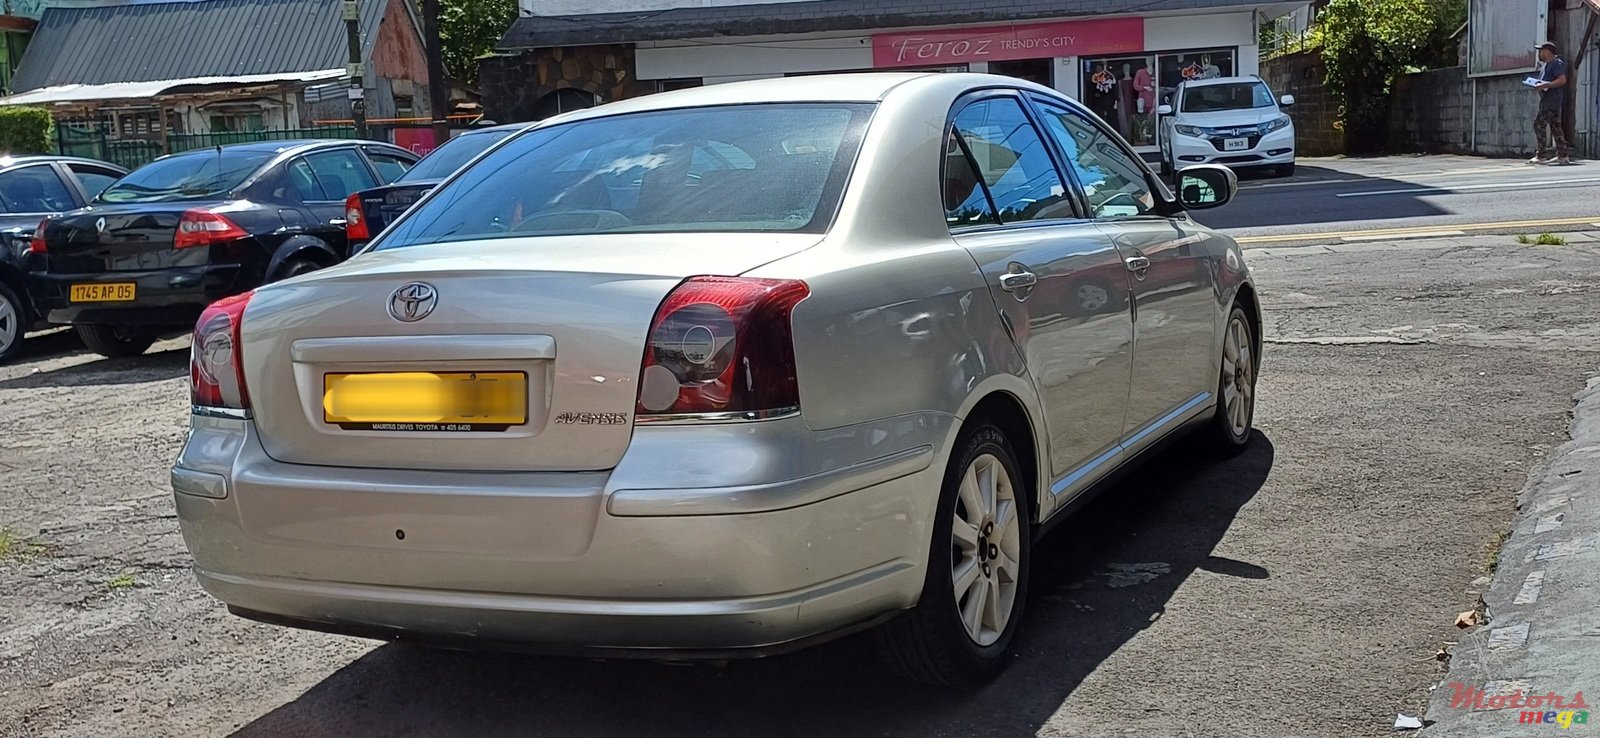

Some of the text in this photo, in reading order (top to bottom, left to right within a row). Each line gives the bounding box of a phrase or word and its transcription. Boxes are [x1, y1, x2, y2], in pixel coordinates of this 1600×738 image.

[891, 37, 993, 62] Feroz
[1000, 37, 1050, 50] TRENDY'S
[1052, 35, 1076, 47] CITY
[75, 285, 132, 300] 1745 AP 05
[554, 411, 628, 425] AVENSIS
